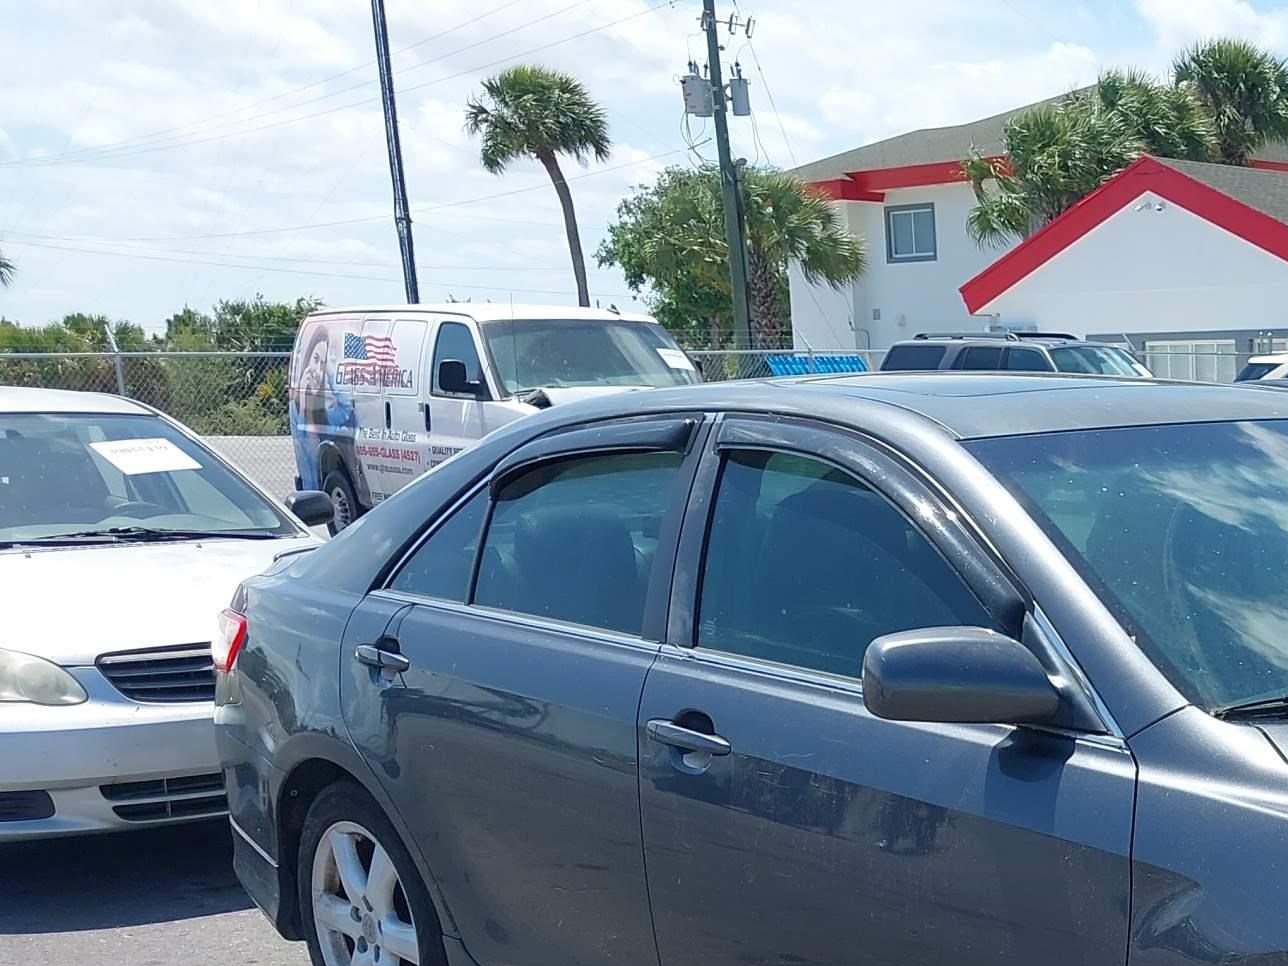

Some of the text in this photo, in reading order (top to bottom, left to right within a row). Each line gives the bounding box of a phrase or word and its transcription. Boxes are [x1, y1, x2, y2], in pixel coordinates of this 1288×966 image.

[367, 362, 412, 388] AMERICA
[387, 430, 400, 442] Auto
[401, 430, 417, 443] Glass
[431, 446, 452, 456] QUALITY
